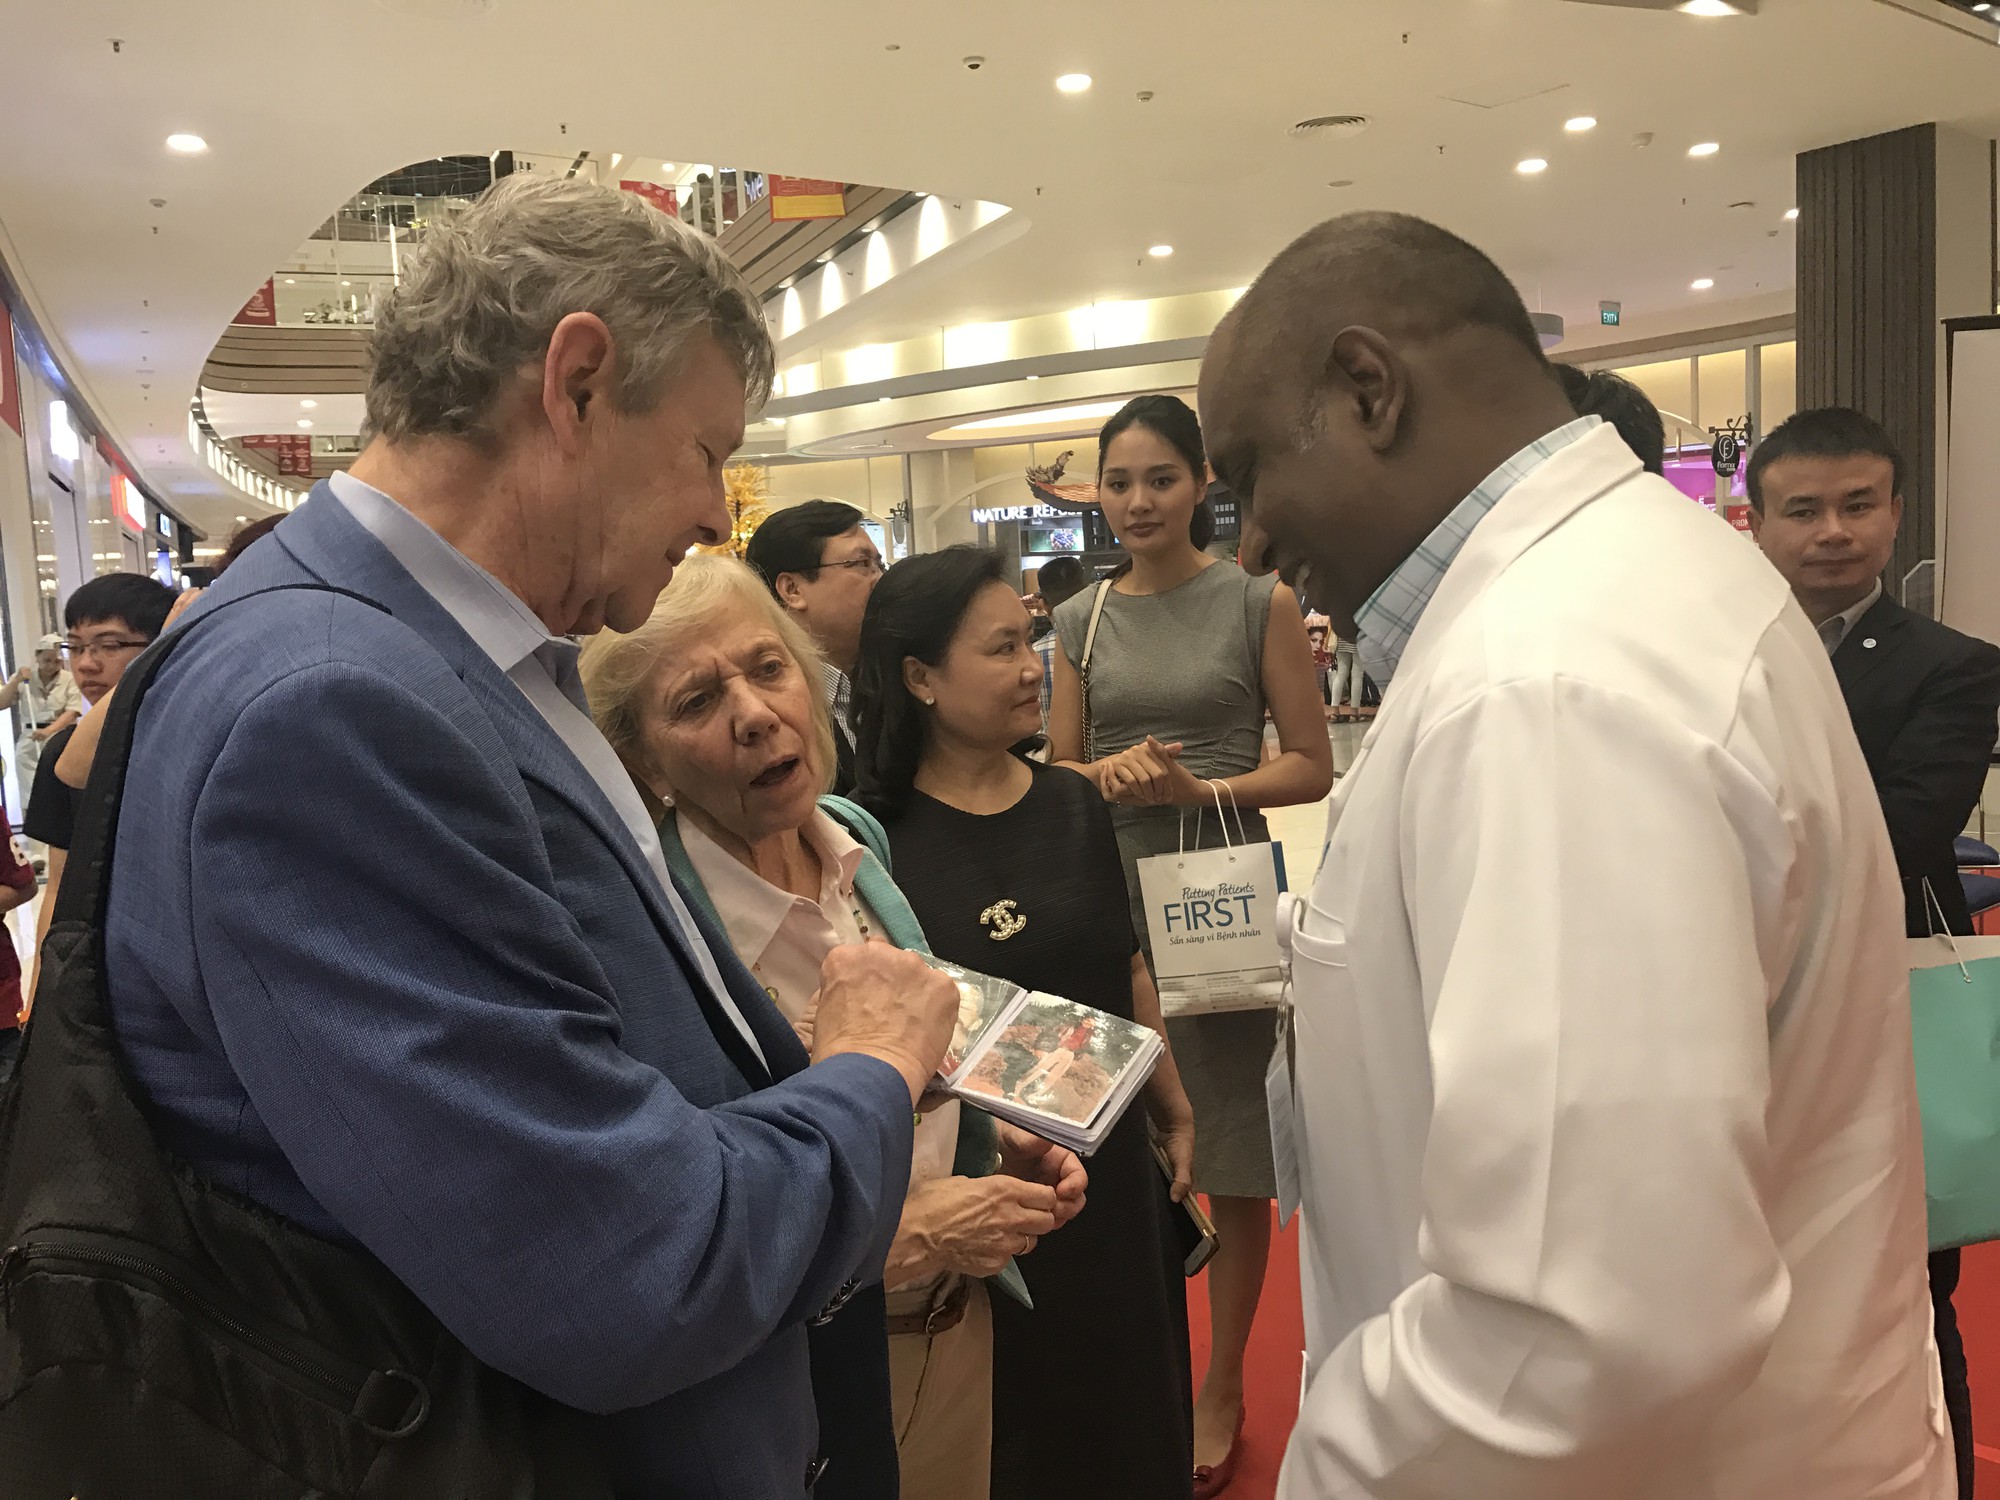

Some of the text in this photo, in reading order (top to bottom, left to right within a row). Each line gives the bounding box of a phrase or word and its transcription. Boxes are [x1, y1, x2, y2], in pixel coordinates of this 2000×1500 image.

[1603, 312, 1615, 324] EXIT
[972, 506, 1028, 523] NATURE
[1182, 882, 1254, 902] Putting Patients
[1163, 894, 1256, 933] FIRST
